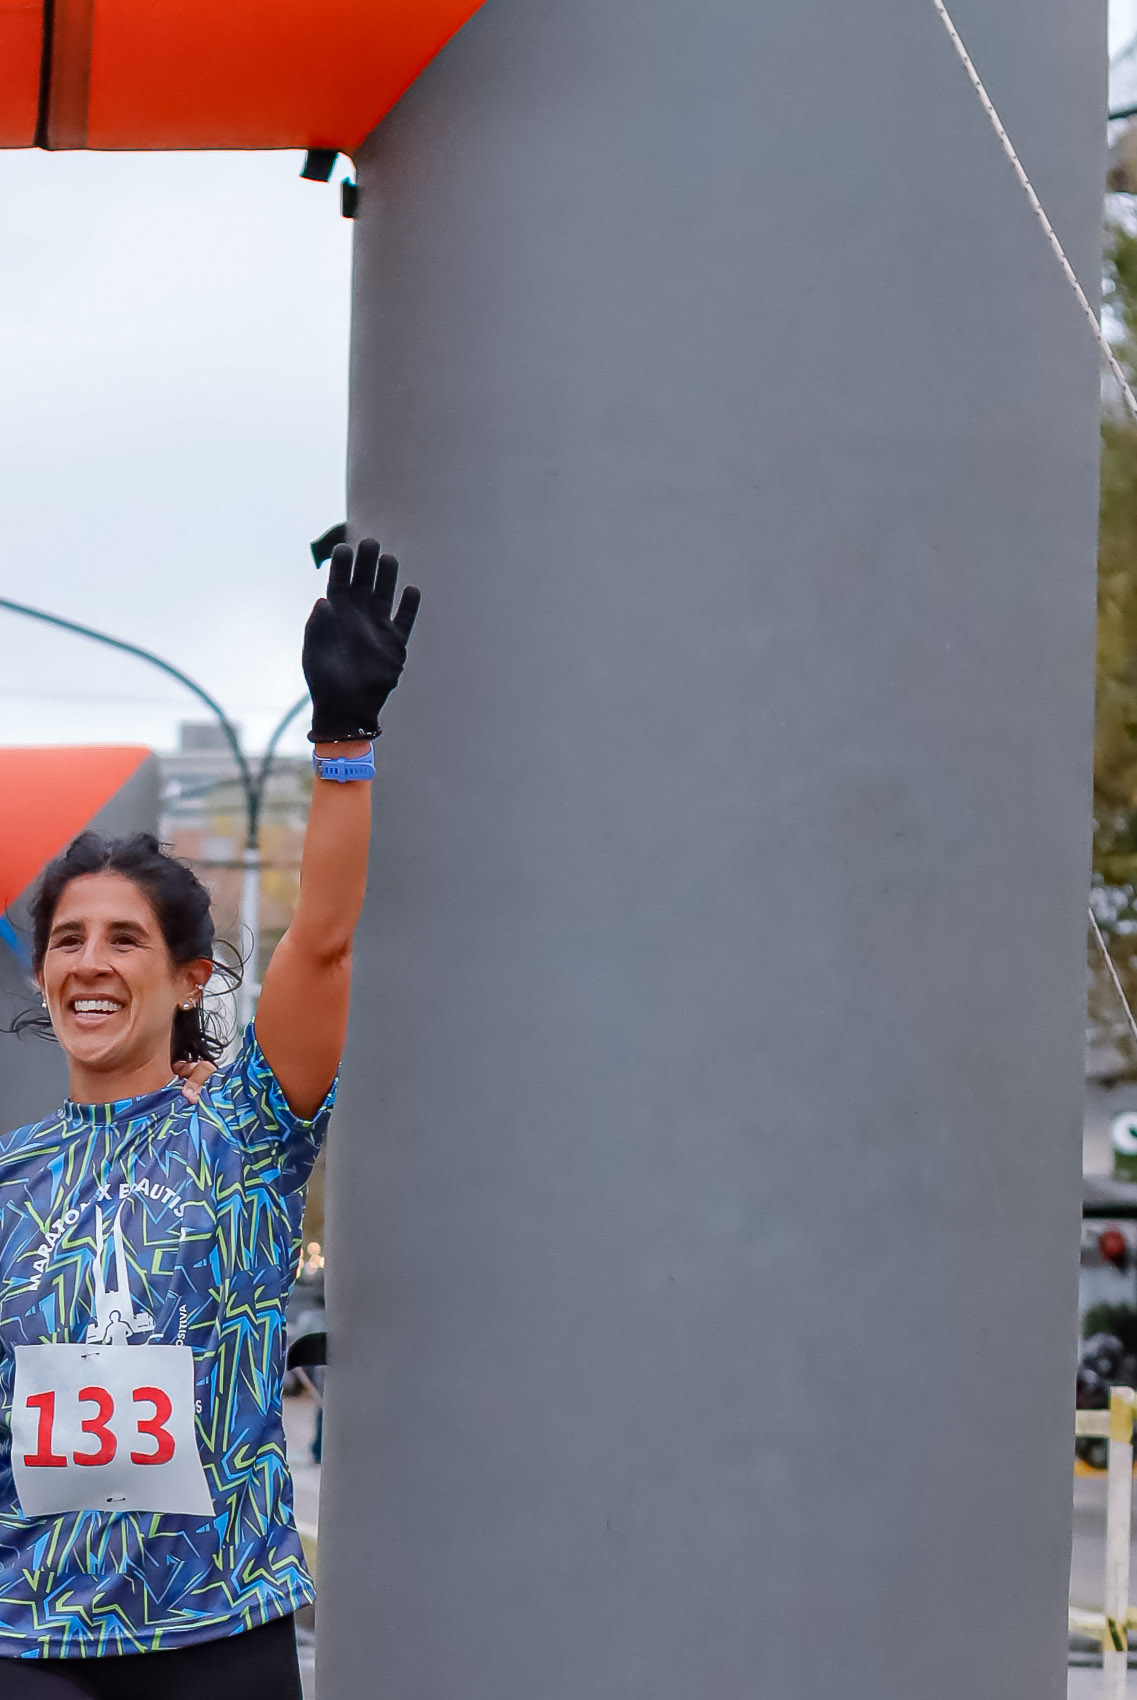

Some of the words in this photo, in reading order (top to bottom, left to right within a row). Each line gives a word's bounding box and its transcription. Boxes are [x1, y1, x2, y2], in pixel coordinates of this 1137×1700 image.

[97, 1183, 112, 1202] X
[175, 1304, 187, 1346] OSITIVA
[23, 1386, 176, 1468] 133
